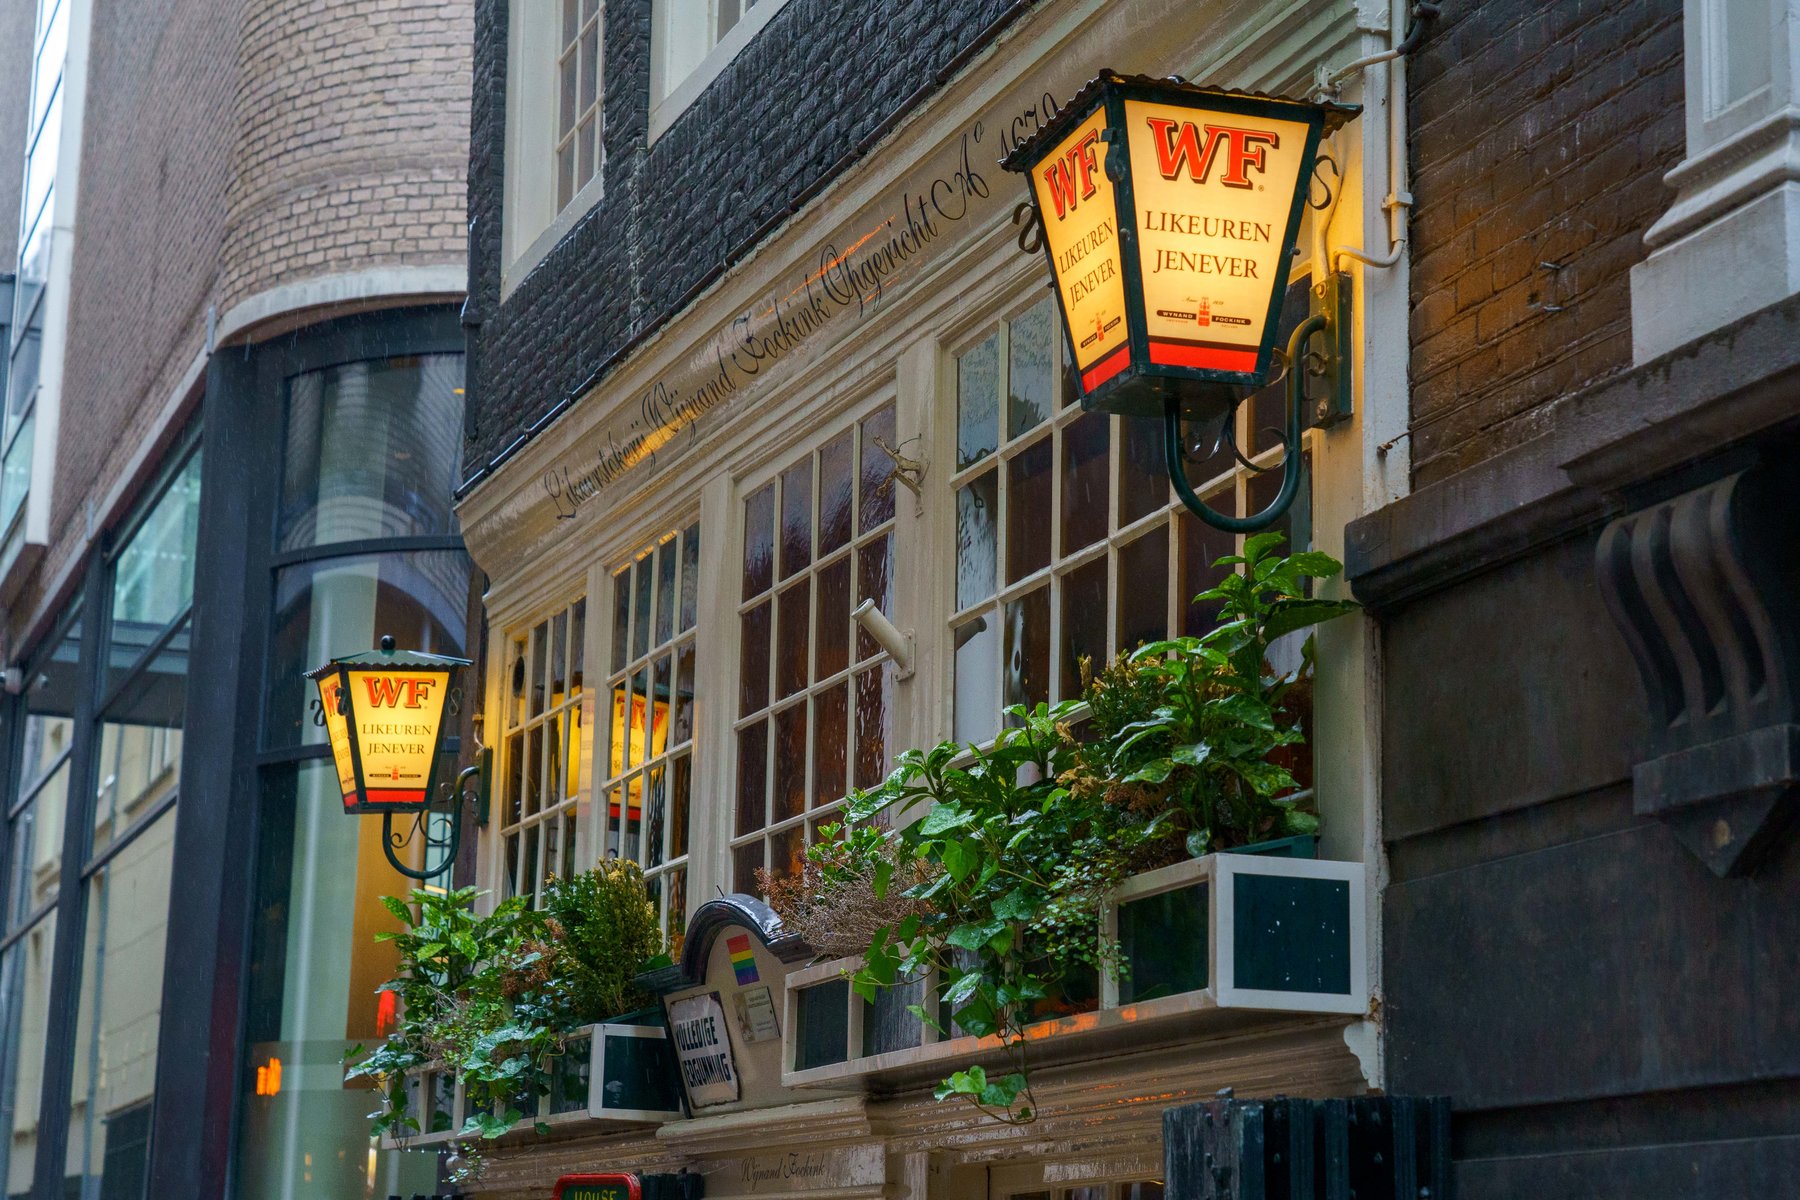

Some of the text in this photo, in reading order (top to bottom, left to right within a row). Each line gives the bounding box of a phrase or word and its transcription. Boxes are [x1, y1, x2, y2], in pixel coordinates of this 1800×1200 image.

[1146, 116, 1280, 190] WF
[1044, 128, 1100, 221] WF
[1144, 210, 1272, 244] LIKEUREN
[1059, 217, 1115, 275] LIKEUREN
[1152, 249, 1259, 280] JENEVER
[732, 274, 831, 375] Fockink
[820, 193, 938, 318] Opgericht
[1069, 258, 1116, 311] JENEVER
[1162, 311, 1246, 325] WYNAND FOCKINK
[363, 677, 436, 709] WF
[362, 723, 432, 736] LIKEUREN
[367, 743, 426, 756] JENEVER
[783, 1152, 825, 1179] Fockink
